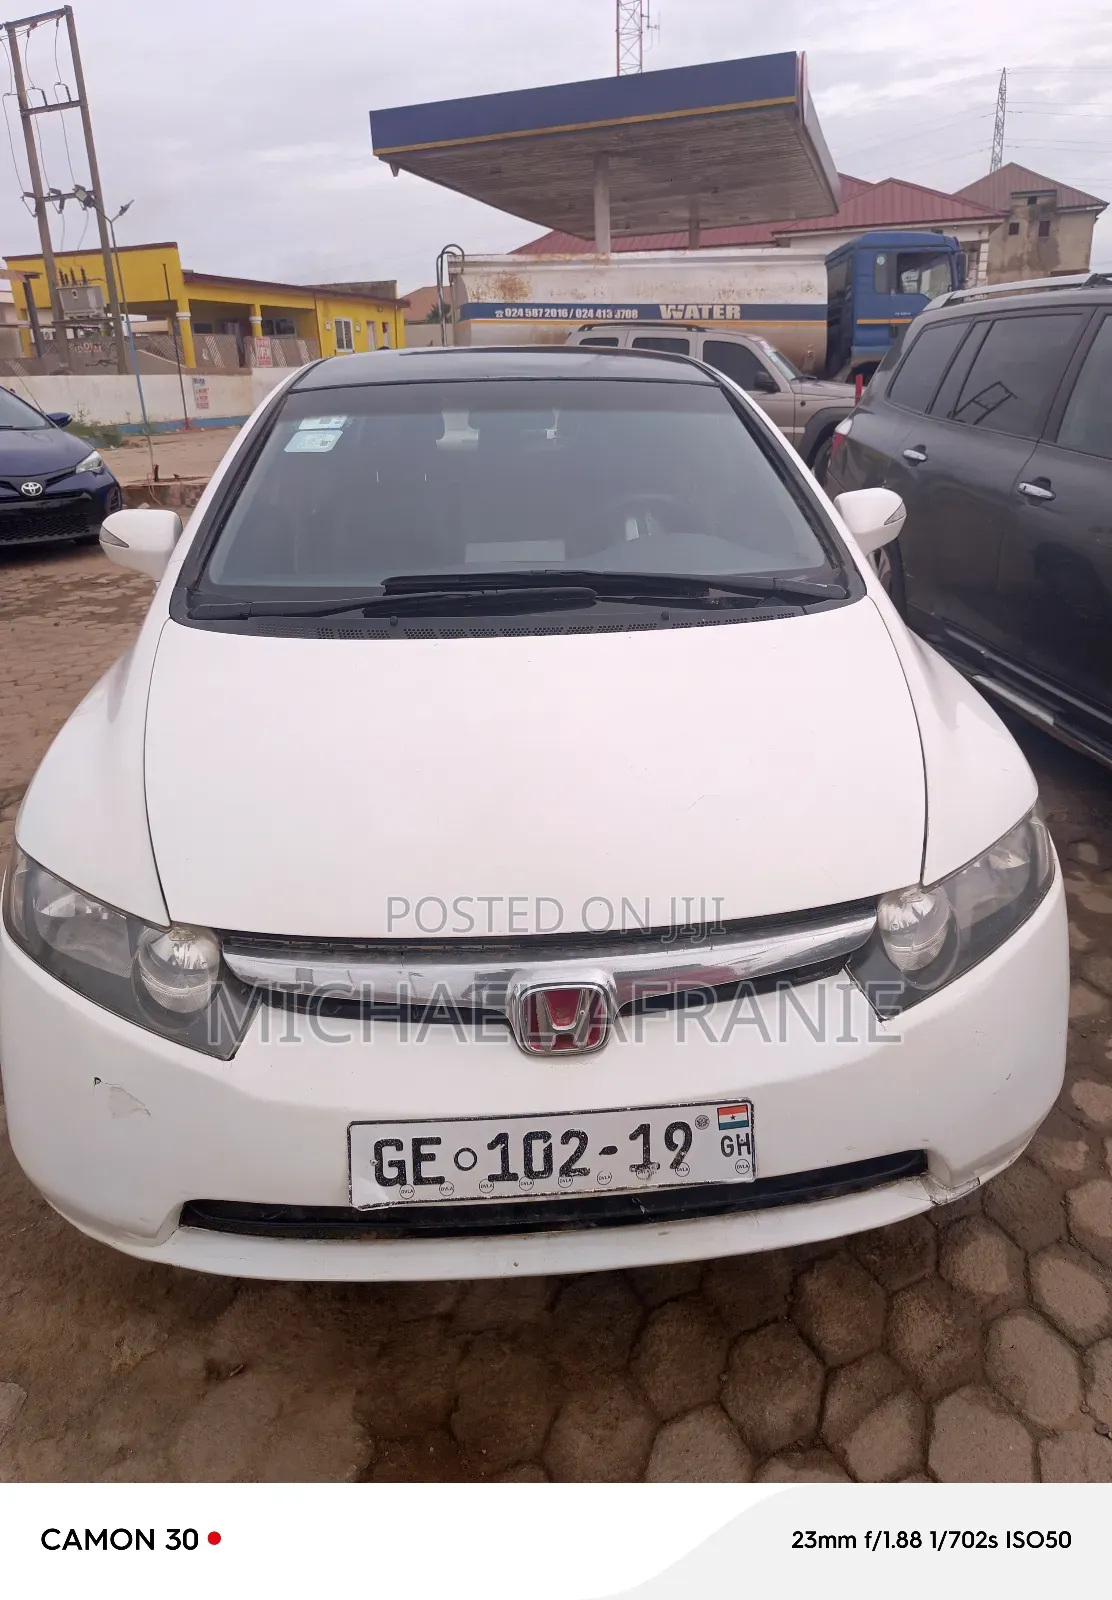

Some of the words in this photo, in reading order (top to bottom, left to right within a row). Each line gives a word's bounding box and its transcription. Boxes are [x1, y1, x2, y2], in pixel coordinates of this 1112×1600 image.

[504, 308, 524, 318] 024
[544, 308, 569, 318] 2016
[575, 308, 594, 319] 024
[659, 304, 741, 320] WATER
[373, 1136, 446, 1187] GE
[486, 1120, 693, 1182] 102-19
[720, 1132, 752, 1158] GH
